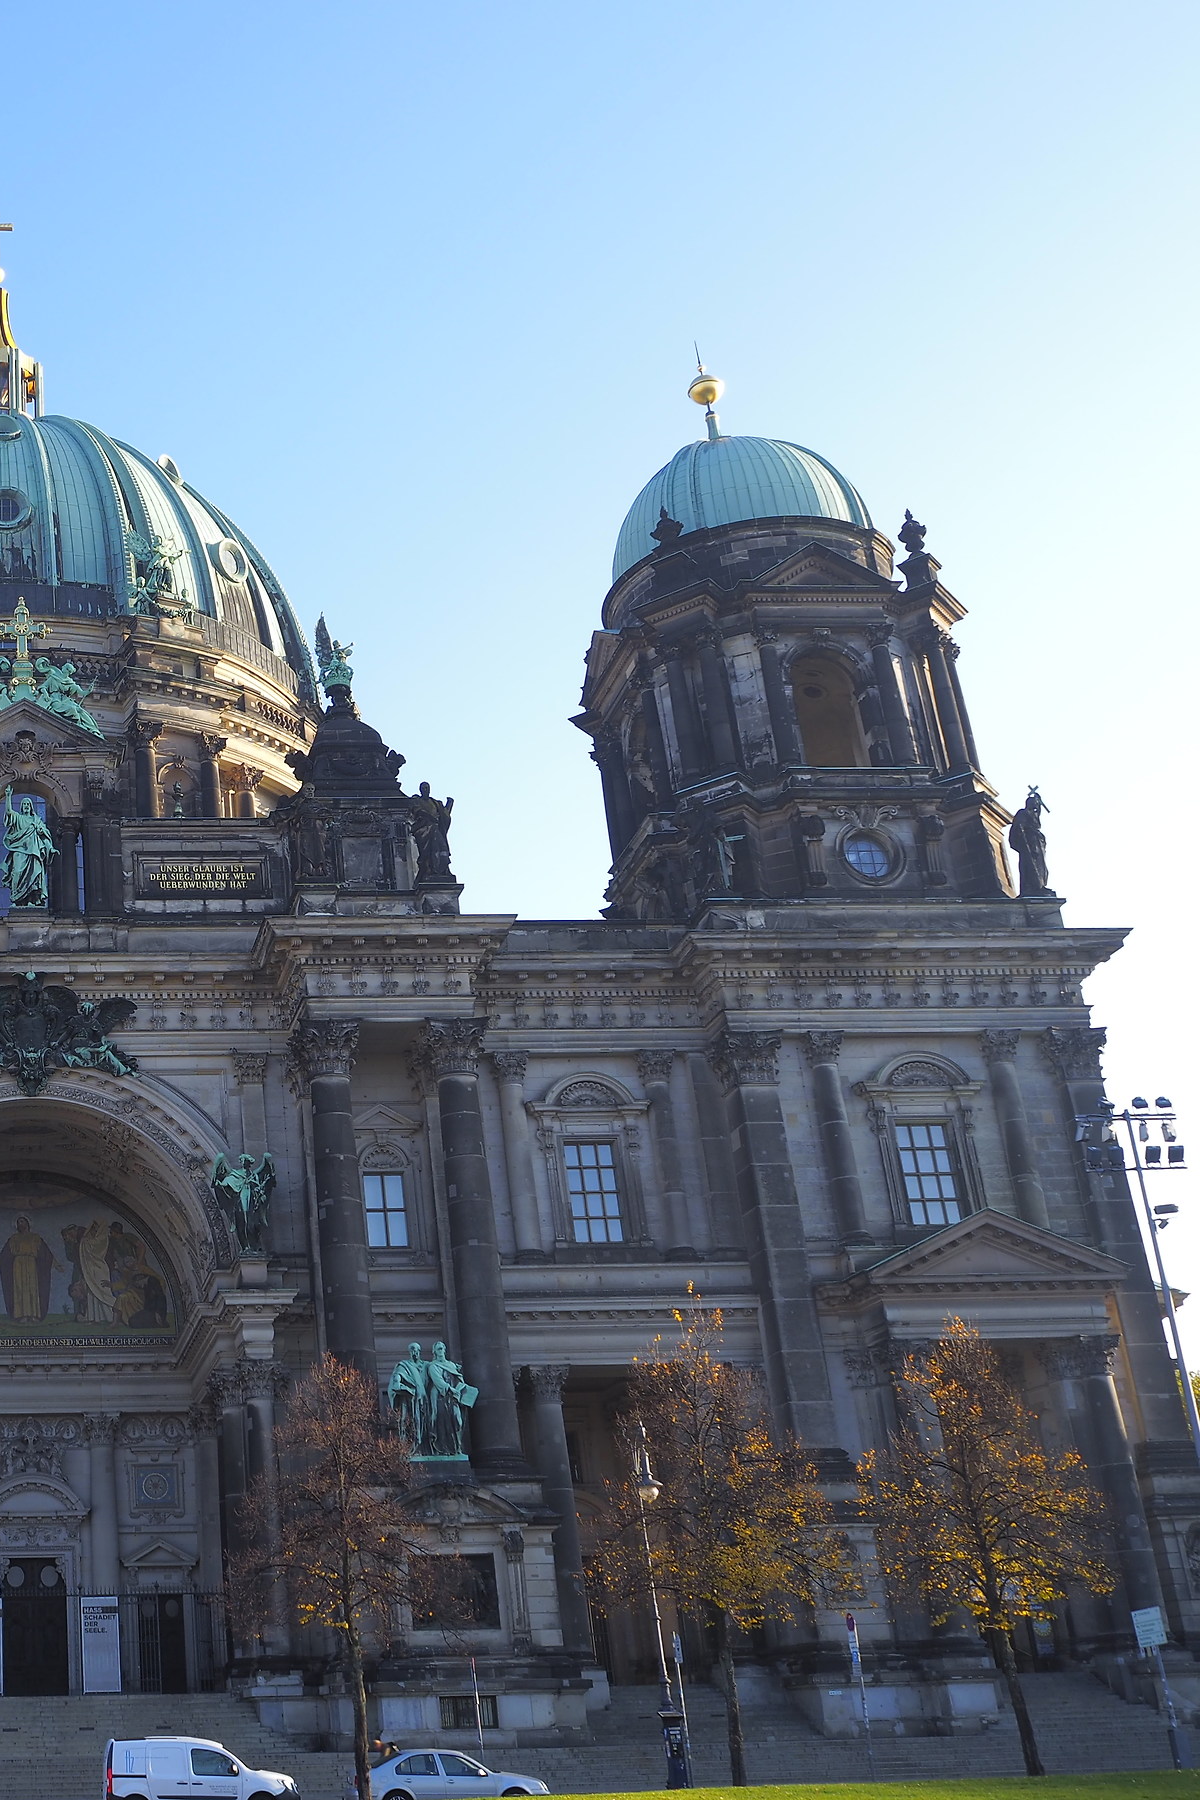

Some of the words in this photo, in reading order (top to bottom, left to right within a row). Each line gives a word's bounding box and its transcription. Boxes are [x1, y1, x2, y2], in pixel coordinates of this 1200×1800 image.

[160, 865, 189, 873] UNSER
[192, 865, 227, 873] GLAUBE
[231, 865, 245, 873] IST
[150, 873, 167, 881] DER
[170, 873, 193, 881] SIEG,
[194, 873, 212, 881] DER
[215, 873, 231, 881] DIE
[233, 873, 256, 881] WELT
[160, 881, 226, 889] UEBERWUNDEN
[230, 881, 248, 889] HAT.
